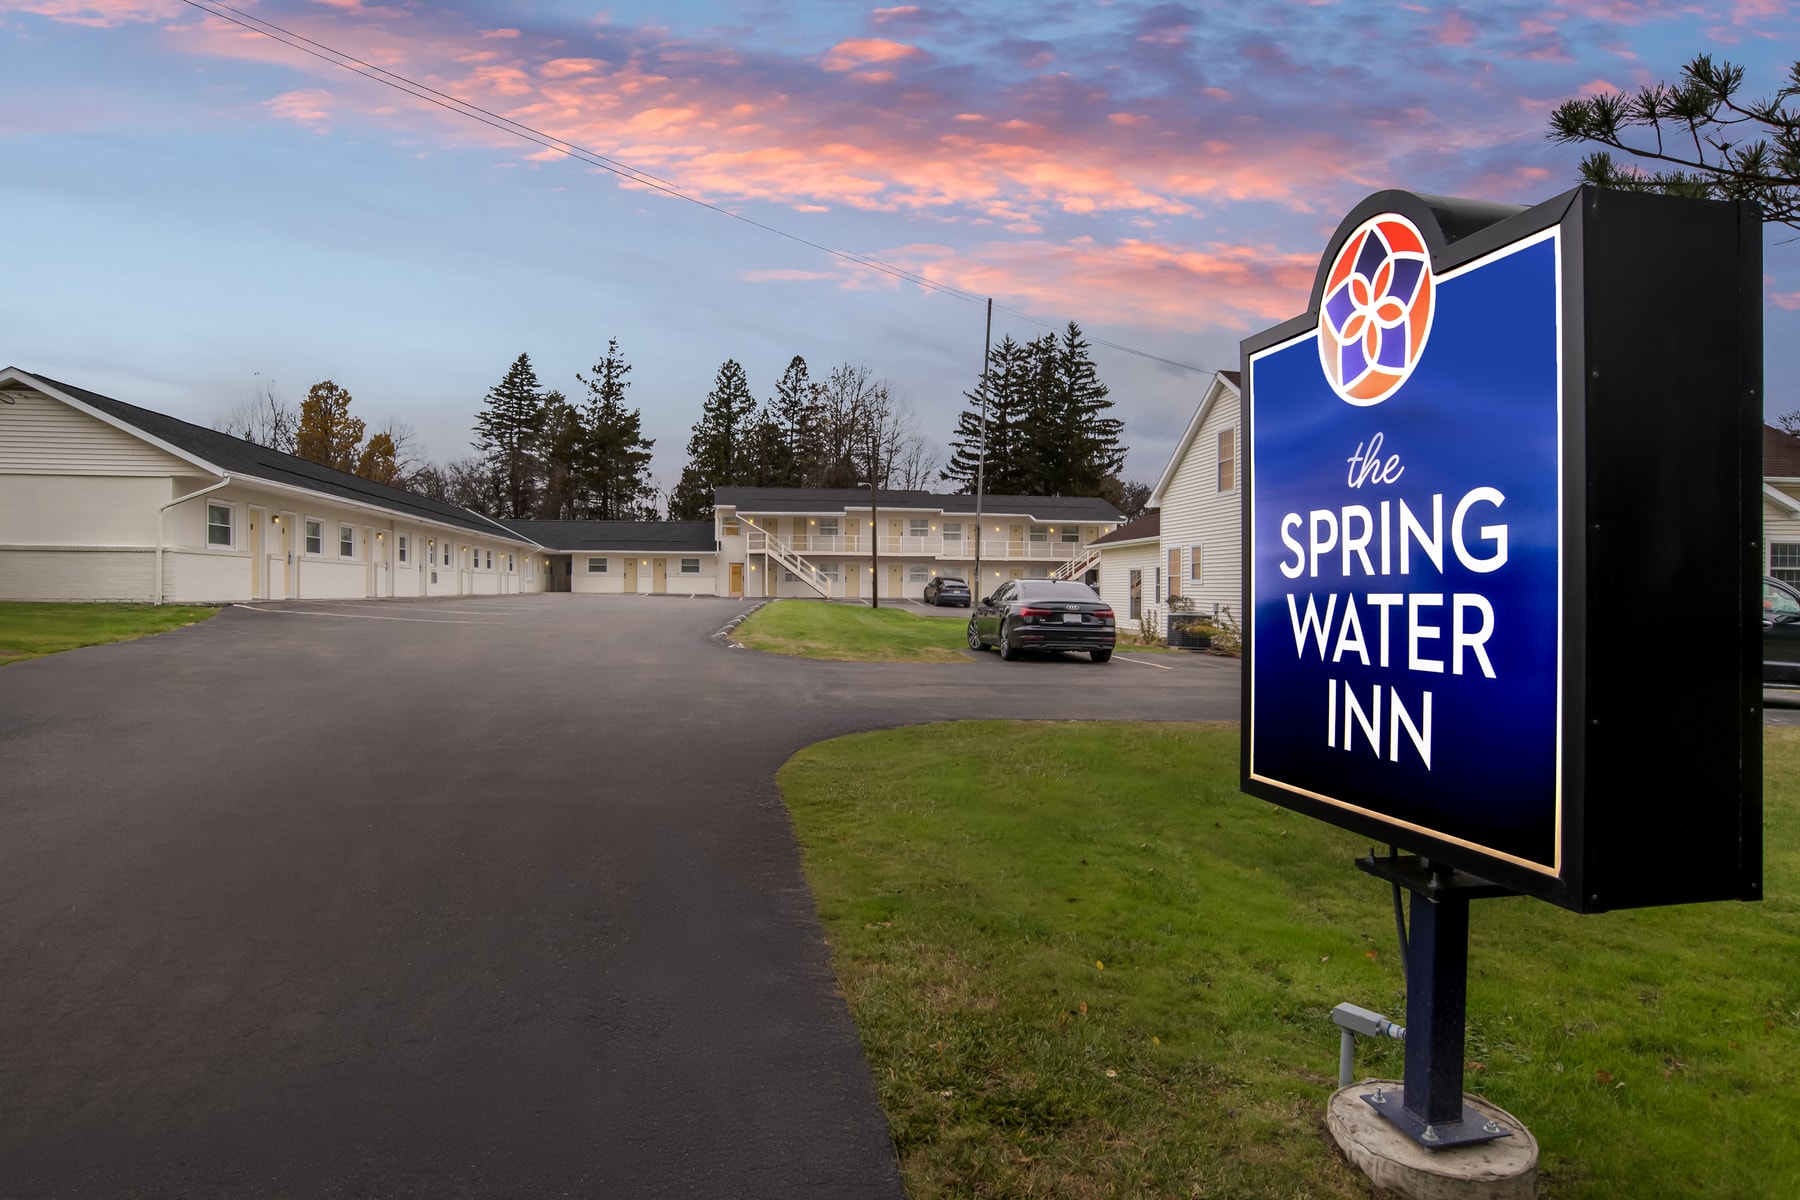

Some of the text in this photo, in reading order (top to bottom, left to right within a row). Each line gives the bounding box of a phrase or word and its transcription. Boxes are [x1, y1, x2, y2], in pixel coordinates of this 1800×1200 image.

[1346, 432, 1404, 488] the
[1279, 486, 1509, 579] SPRING
[1286, 593, 1497, 679] WATER
[1328, 679, 1432, 772] INN
